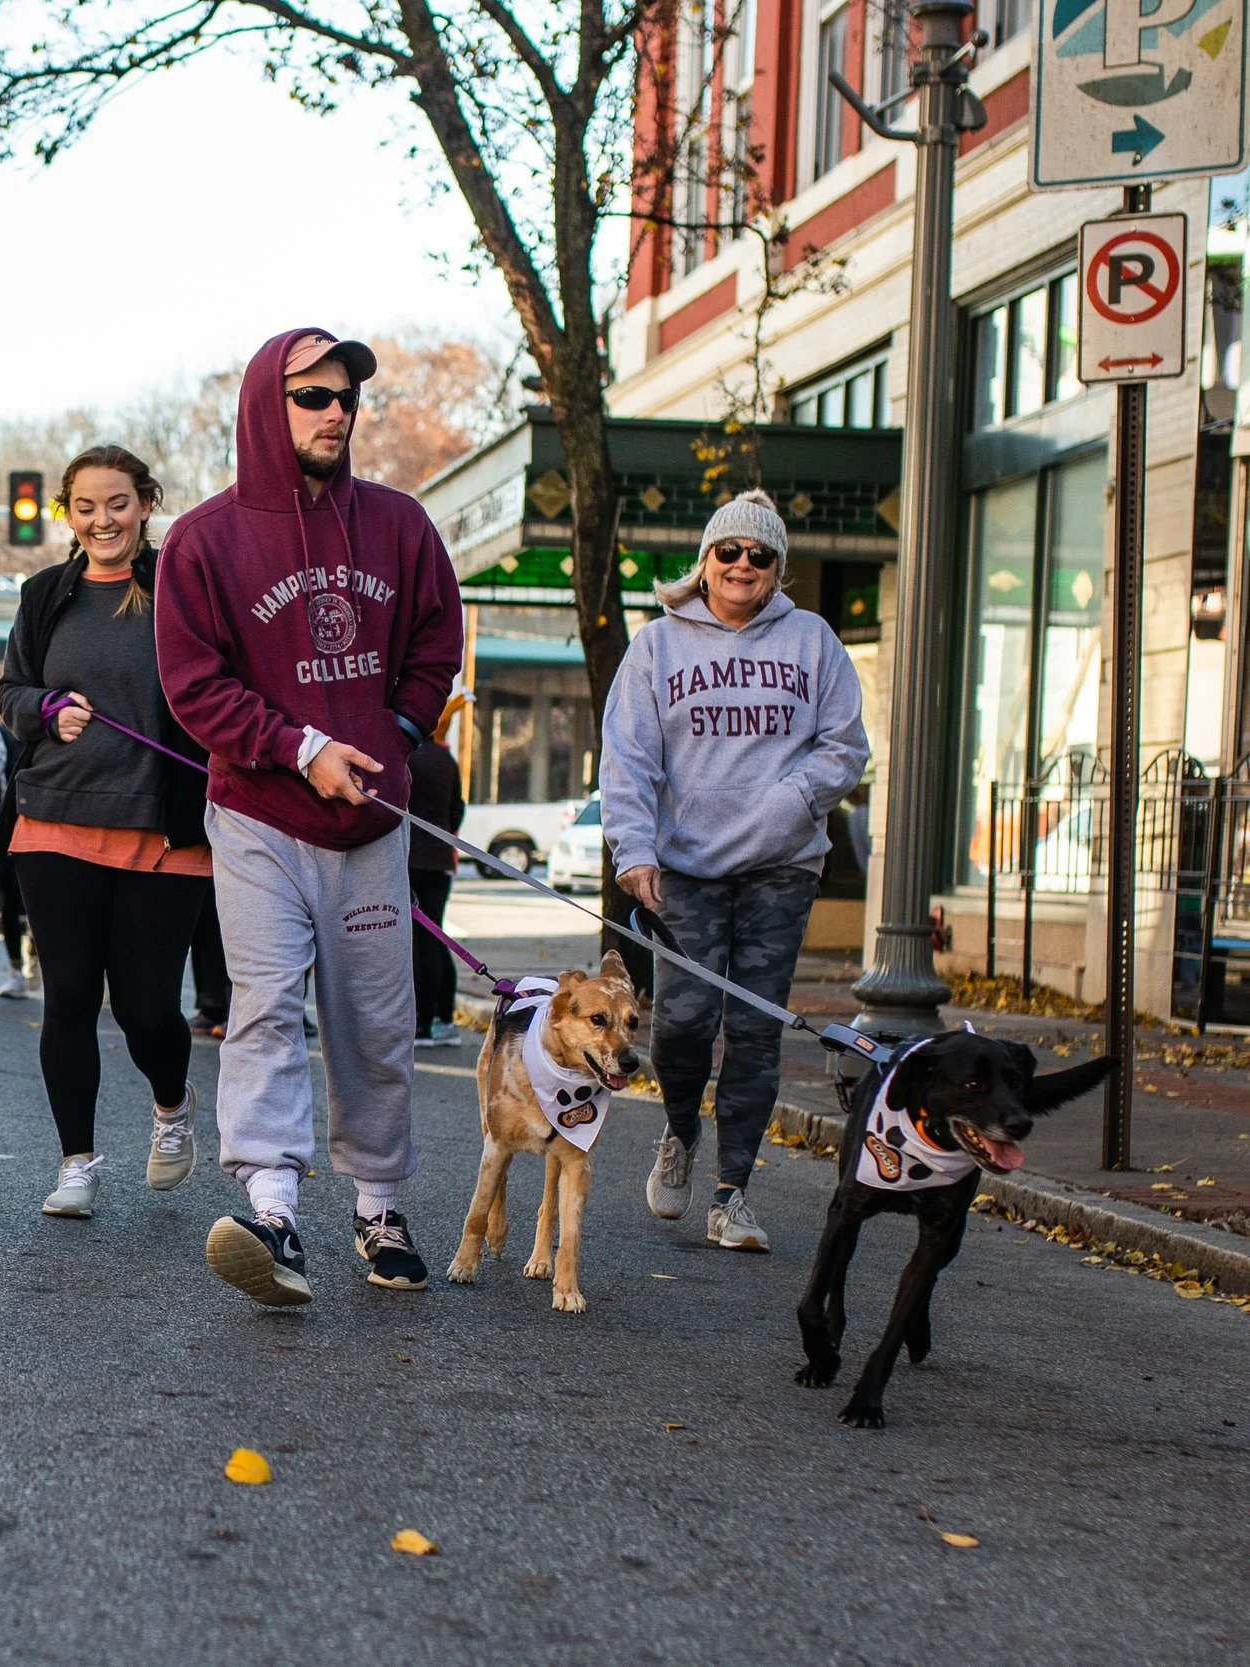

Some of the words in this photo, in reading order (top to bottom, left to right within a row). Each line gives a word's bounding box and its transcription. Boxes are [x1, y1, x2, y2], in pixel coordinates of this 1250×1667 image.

[1108, 253, 1155, 305] P
[296, 650, 382, 684] COLLEGE
[666, 656, 811, 709] HAMPDEN
[689, 704, 796, 737] SYDNEY
[342, 904, 380, 922] WILLIAM
[346, 918, 398, 933] WRESTLING
[872, 1142, 900, 1176] DASH
